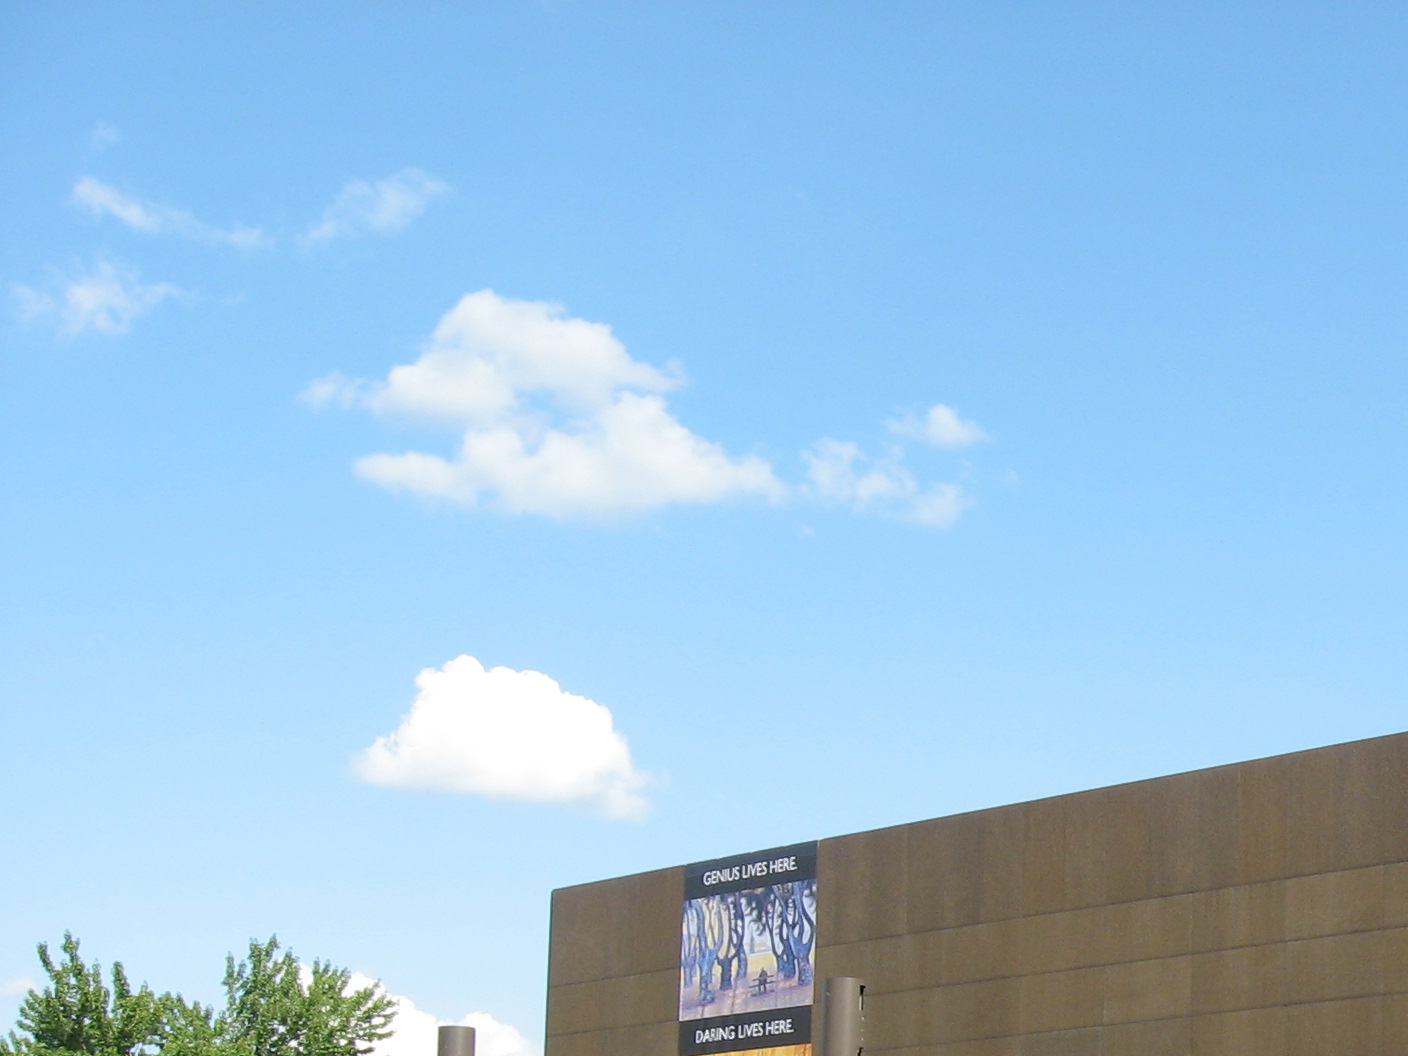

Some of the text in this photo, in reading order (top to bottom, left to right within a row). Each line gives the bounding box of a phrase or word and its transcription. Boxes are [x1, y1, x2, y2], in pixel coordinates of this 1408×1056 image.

[703, 867, 740, 886] GENIUS
[742, 861, 767, 879] LIVES
[695, 1026, 735, 1044] DARING
[738, 1022, 763, 1039] LIVES
